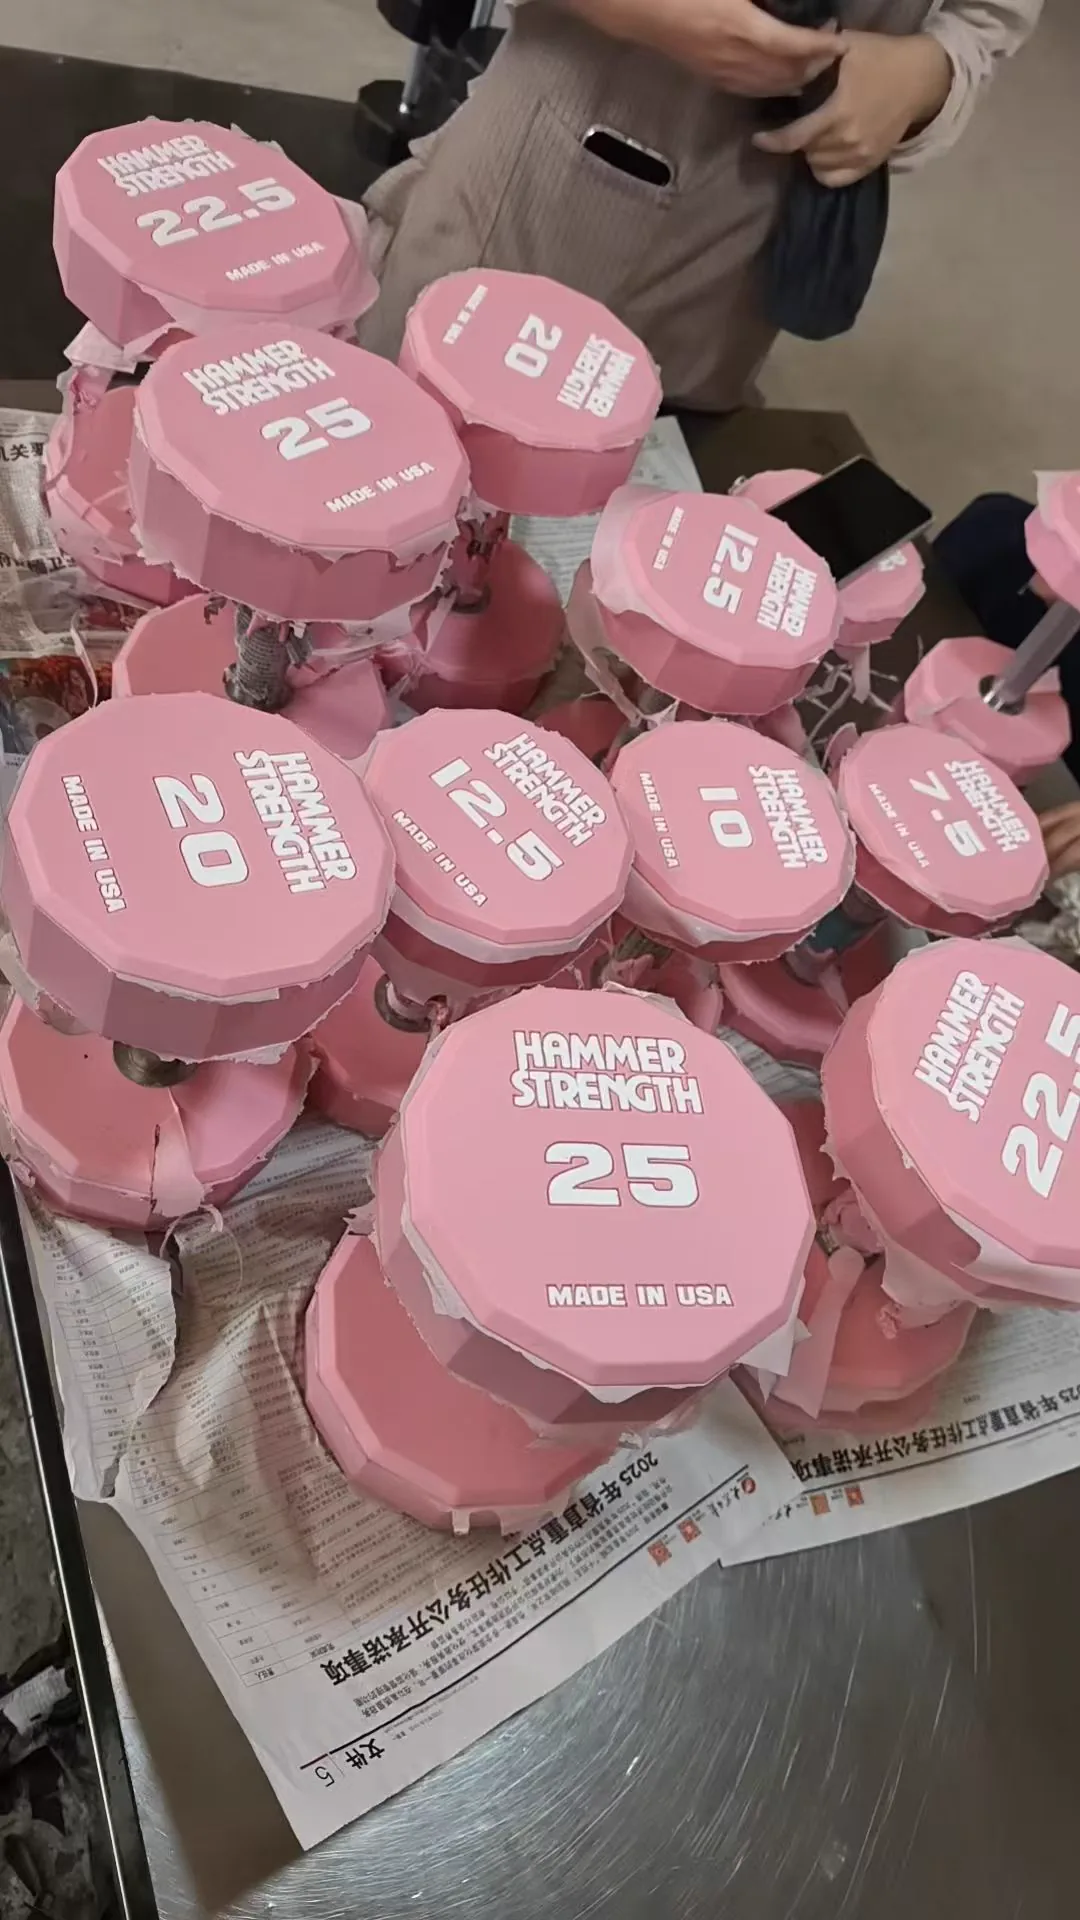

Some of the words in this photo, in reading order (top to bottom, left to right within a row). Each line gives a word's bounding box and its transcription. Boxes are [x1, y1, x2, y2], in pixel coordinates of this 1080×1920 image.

[97, 135, 208, 177] HAMMER
[114, 152, 237, 197] STRENGTH
[137, 177, 297, 247] 22.5
[225, 259, 271, 281] MADE
[274, 251, 290, 267] IN
[292, 241, 325, 258] USA
[182, 340, 308, 394] HAMMER
[504, 313, 563, 378] 20
[200, 357, 336, 415] STRENGTH
[260, 398, 372, 461] 25
[325, 486, 377, 513] MADE
[379, 476, 398, 492] IN
[399, 461, 435, 483] USA
[702, 524, 759, 615] 12.5
[61, 775, 99, 833] MADE
[482, 742, 595, 847] STRENGTH
[506, 732, 607, 829] HAMMER
[639, 772, 662, 813] MADE
[944, 761, 1018, 852] STRENGTH
[958, 760, 1030, 846] HAMMER
[152, 773, 250, 887] 20
[233, 749, 327, 895] STRENGTH
[270, 751, 357, 881] HAMMER
[429, 757, 564, 881] 12.5
[653, 816, 669, 833] IN
[698, 786, 754, 848] 10
[748, 764, 807, 869] STRENGTH
[771, 767, 828, 866] HAMMER
[867, 783, 898, 818] MADE
[895, 819, 909, 837] IN
[907, 839, 930, 869] USA
[909, 770, 986, 857] 7.5
[83, 837, 110, 862] IN
[392, 810, 437, 853] MADE
[434, 853, 457, 874] IN
[454, 873, 488, 907] USA
[659, 837, 681, 869] USA
[94, 868, 127, 914] USA
[512, 1030, 688, 1075] HAMMER
[913, 970, 990, 1095] HAMMER
[948, 983, 1025, 1125] STRENGTH
[511, 1068, 704, 1115] STRENGTH
[544, 1141, 700, 1208] 25
[546, 1283, 628, 1308] MADE
[637, 1284, 667, 1307] IN
[677, 1284, 734, 1309] USA
[314, 1766, 335, 1787] 5
[346, 1737, 385, 1770] 文件
